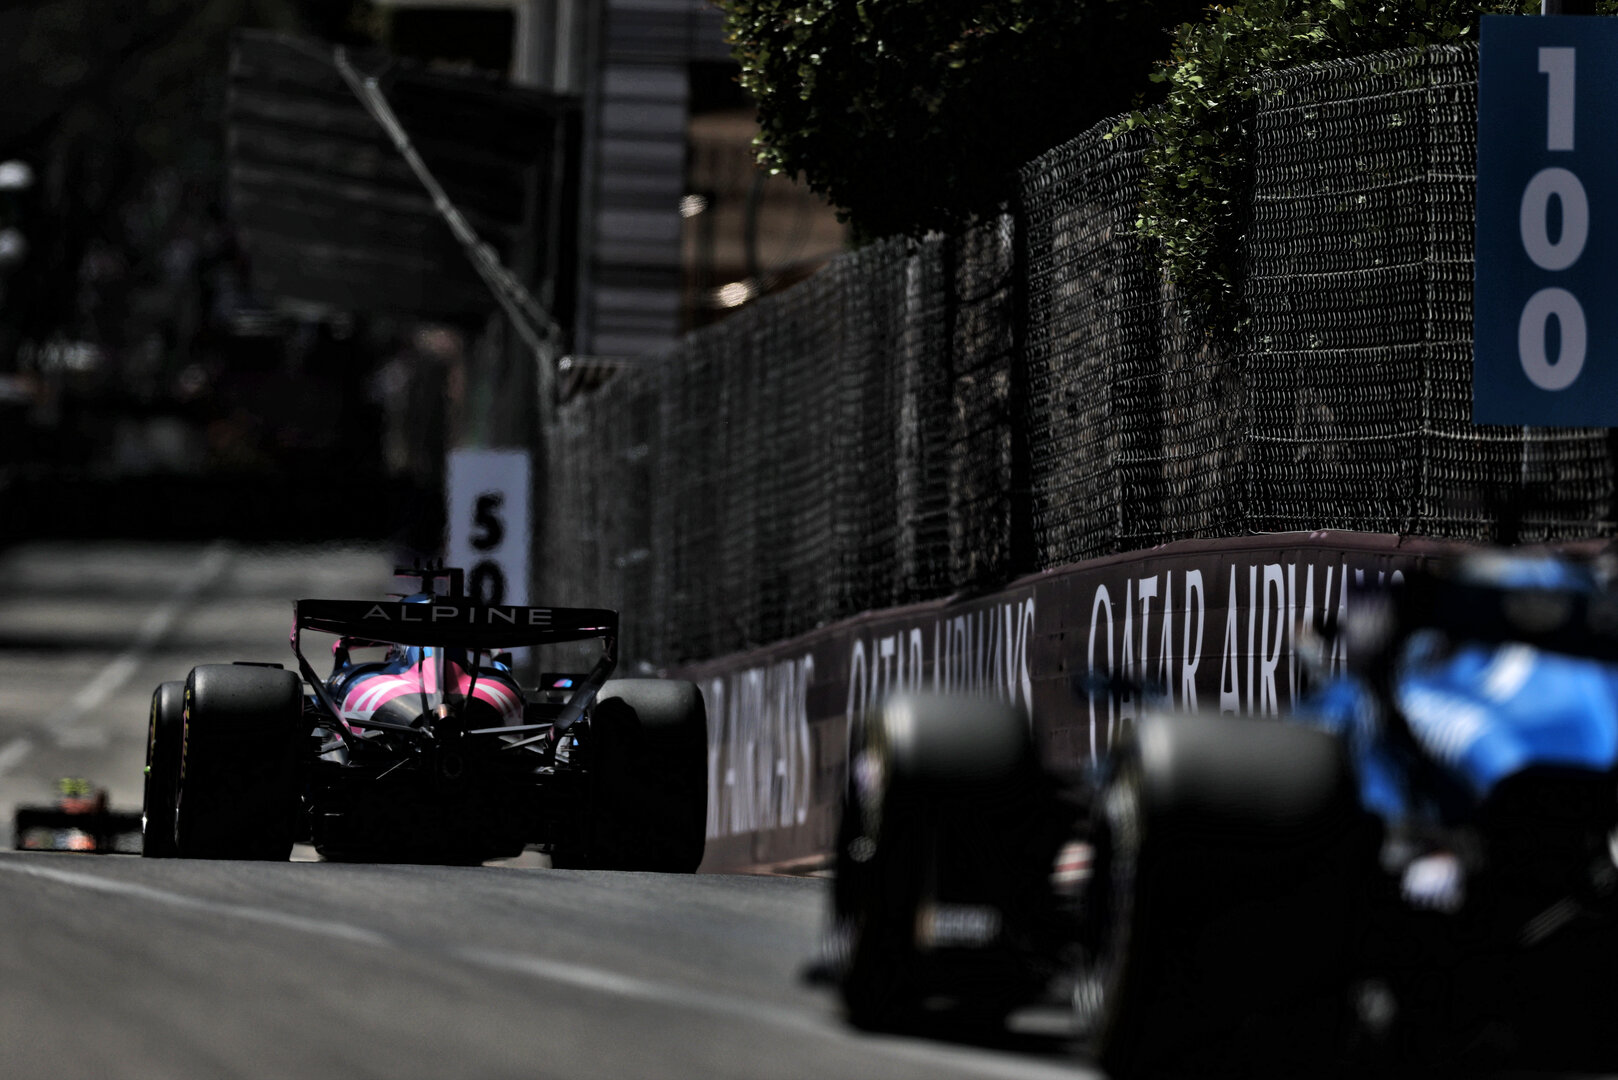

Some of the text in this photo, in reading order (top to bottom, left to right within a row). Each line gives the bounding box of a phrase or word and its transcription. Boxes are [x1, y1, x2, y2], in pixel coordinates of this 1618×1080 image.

[1518, 47, 1590, 392] 100
[362, 604, 552, 626] ALPINE
[471, 494, 503, 604] 50
[1088, 568, 1205, 768] QATAR
[1219, 563, 1405, 719] AIRWA
